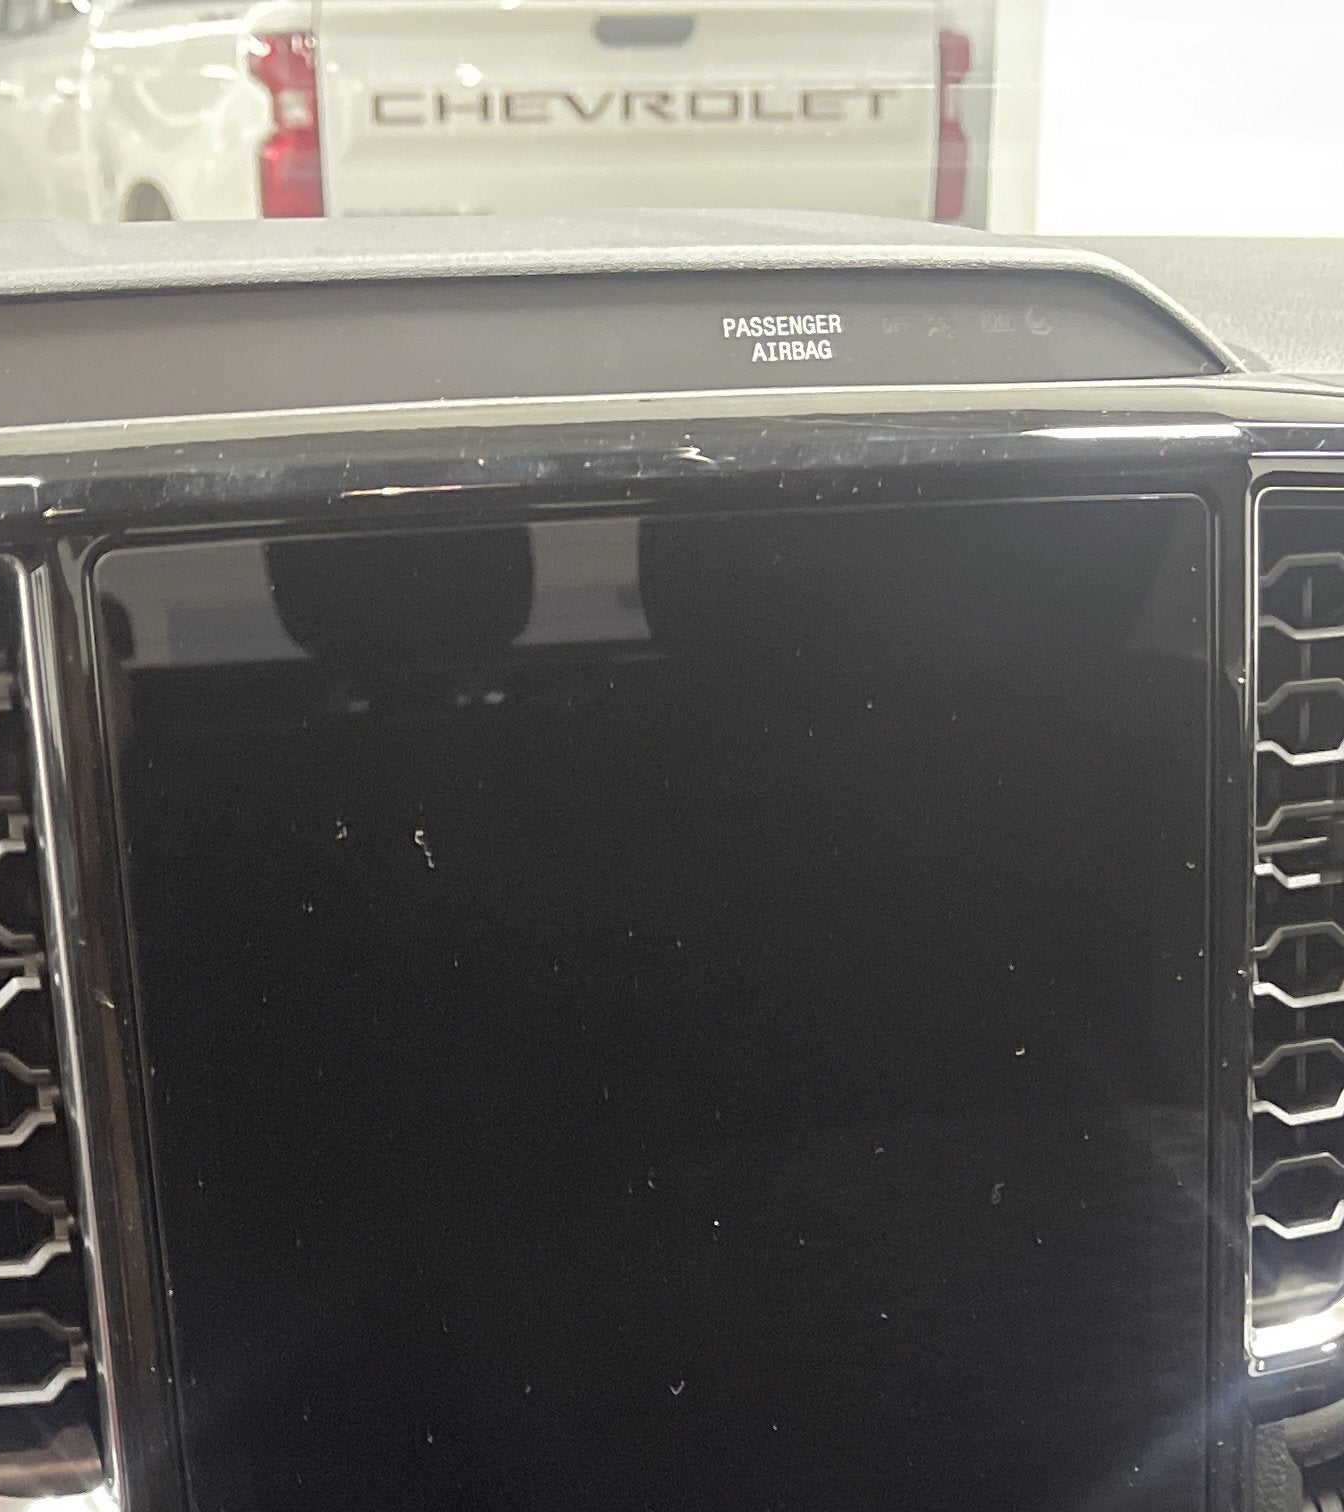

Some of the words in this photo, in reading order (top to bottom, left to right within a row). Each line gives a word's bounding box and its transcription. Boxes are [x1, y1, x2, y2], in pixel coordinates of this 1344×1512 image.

[370, 88, 905, 125] CHEVROLET
[722, 314, 843, 338] PASSENGER
[751, 339, 833, 362] AIRBAG
